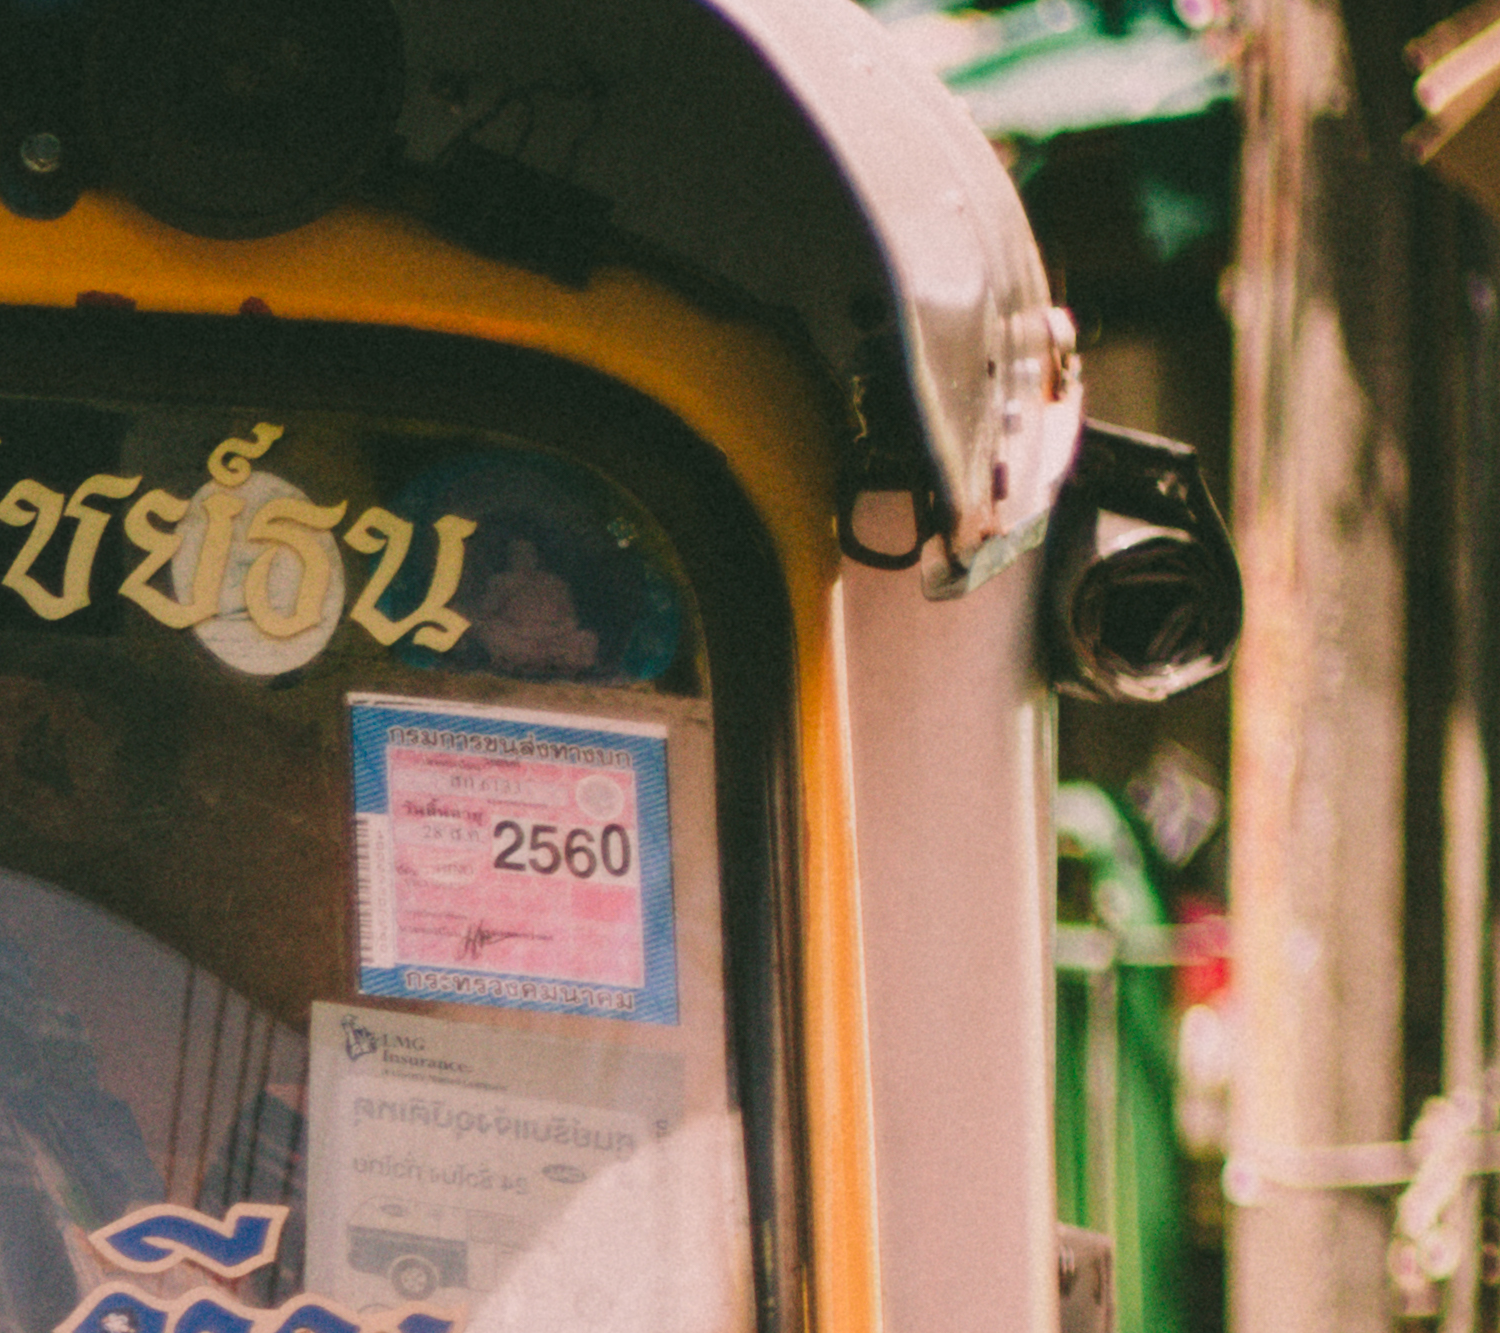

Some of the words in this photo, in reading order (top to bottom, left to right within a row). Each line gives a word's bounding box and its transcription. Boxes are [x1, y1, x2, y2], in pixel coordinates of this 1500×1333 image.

[388, 724, 633, 768] กรมการขนส่งทางบก
[493, 819, 632, 879] 2560
[404, 967, 636, 1011] กระทรวงคมนาคม
